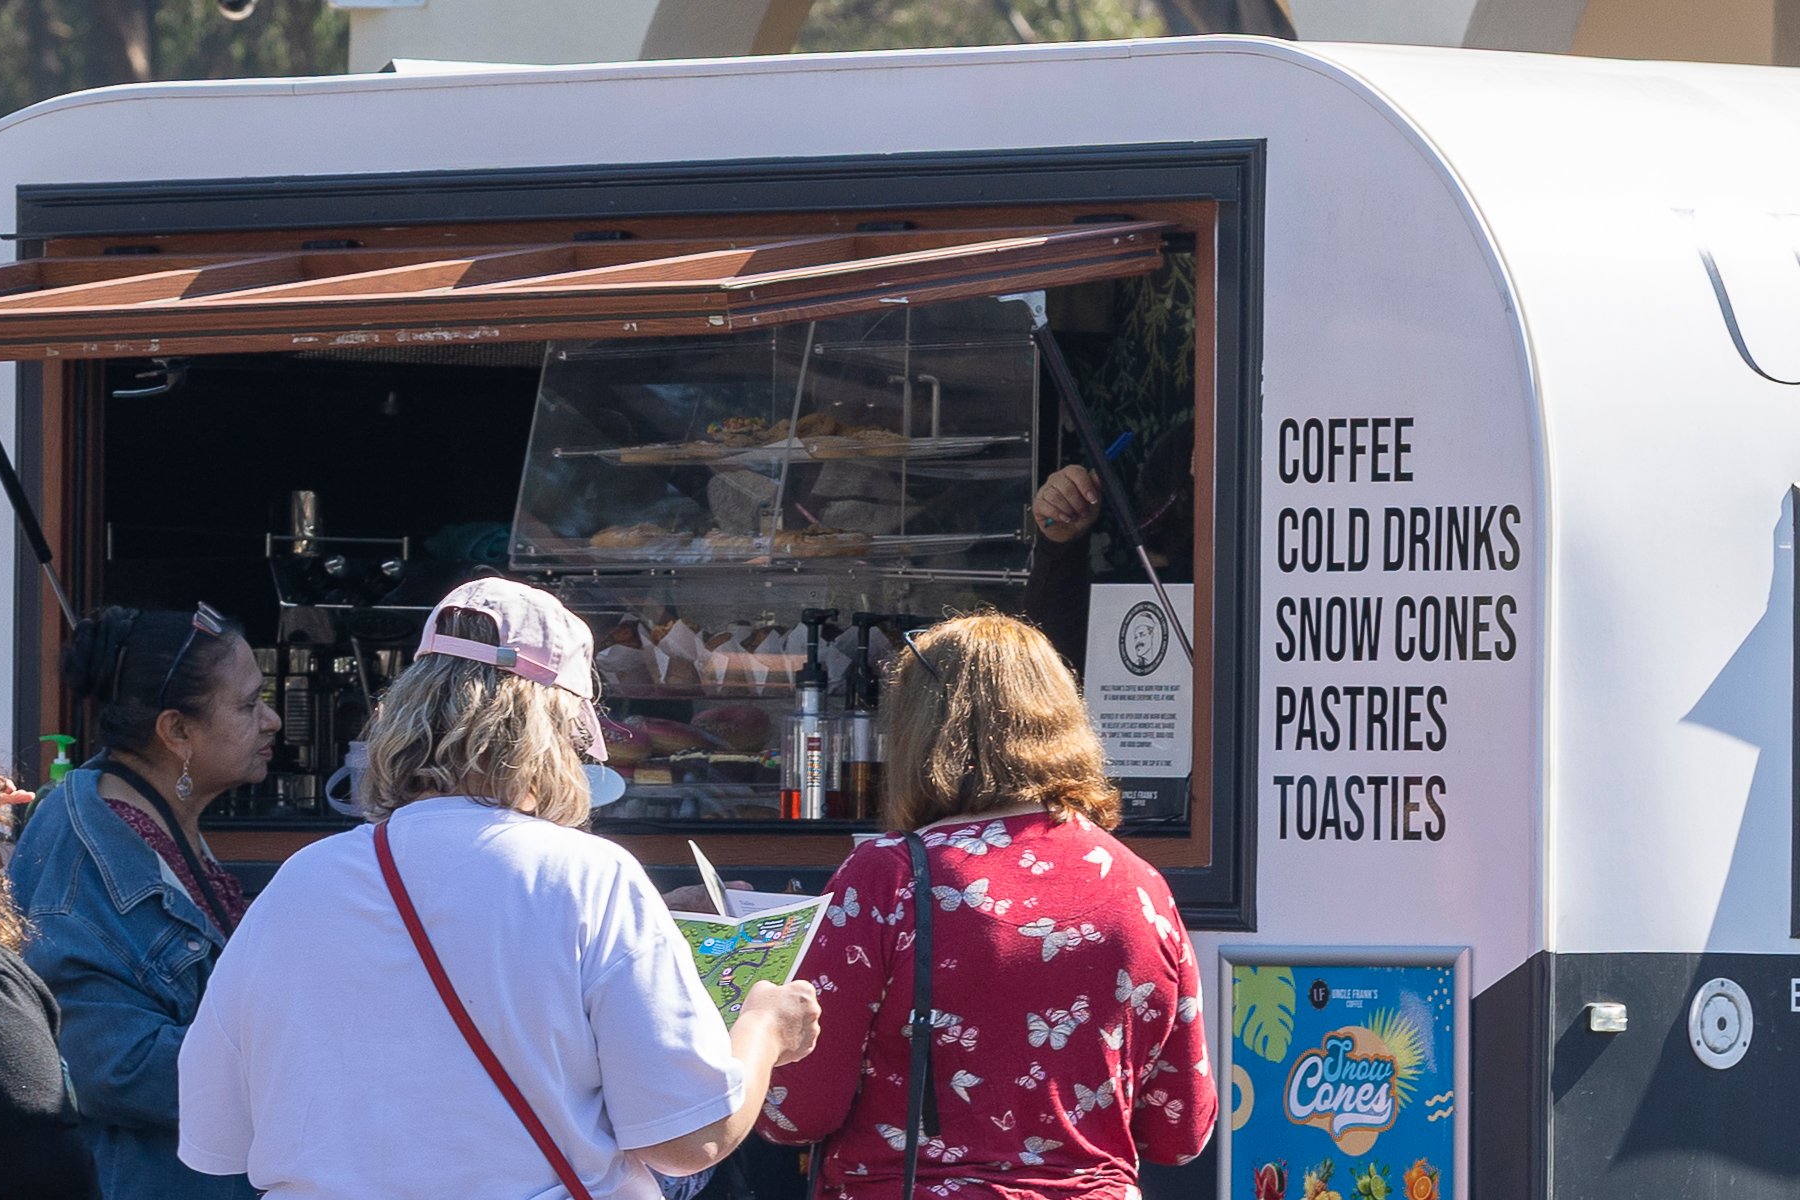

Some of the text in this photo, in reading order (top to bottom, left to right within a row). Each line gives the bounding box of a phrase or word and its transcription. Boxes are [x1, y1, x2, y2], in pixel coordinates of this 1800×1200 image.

[1278, 417, 1415, 484] COFFEE
[1277, 504, 1522, 573] COLD DRINKS
[1275, 595, 1518, 663] SNOW CONES
[1274, 686, 1448, 752] PASTRIES
[1272, 775, 1447, 842] TOASTIES
[1331, 989, 1378, 999] UNCLE FRANK'S
[1324, 1039, 1393, 1082] Snow
[1289, 1056, 1393, 1133] Cones
